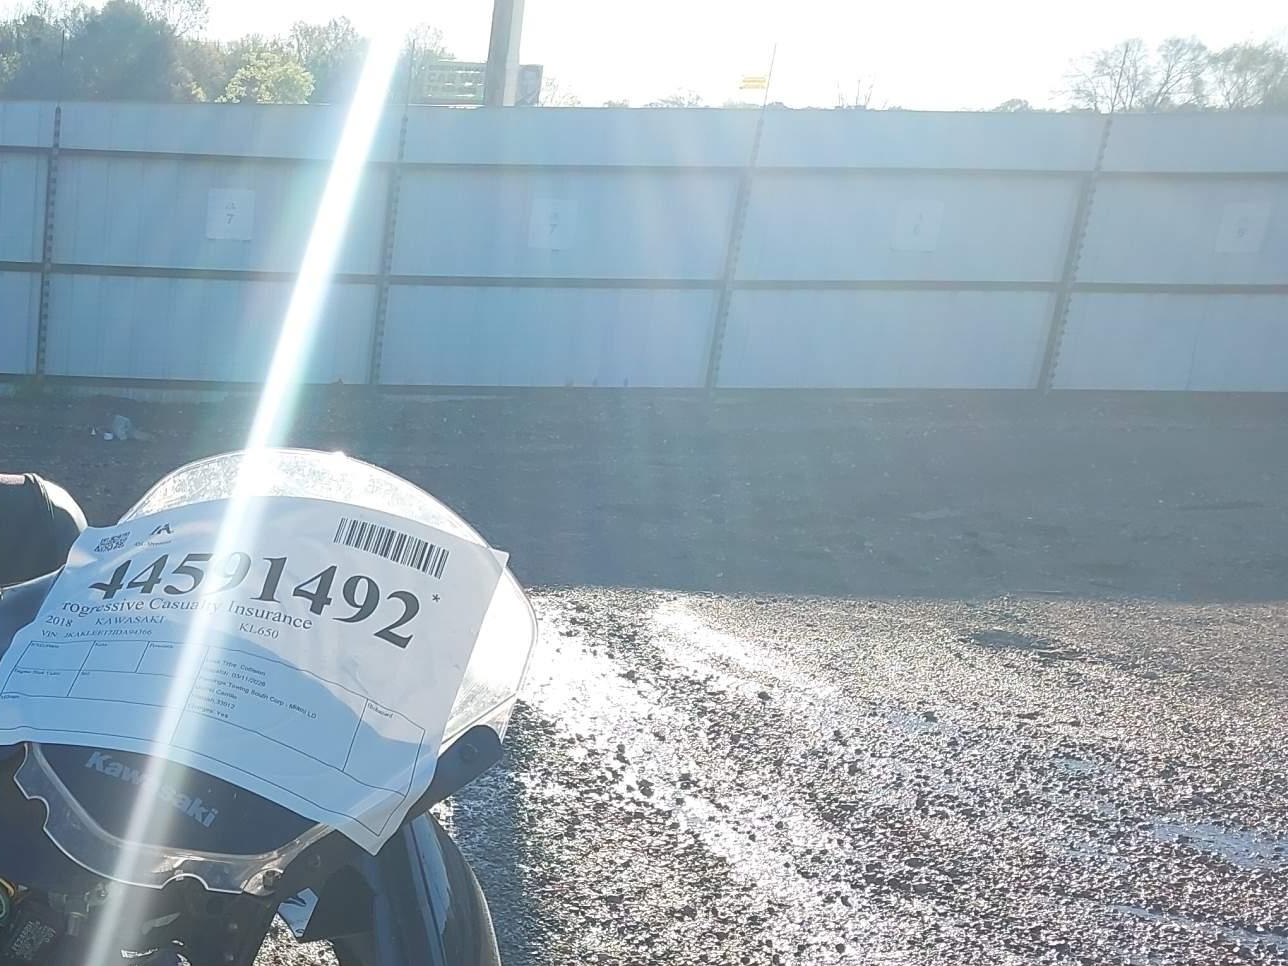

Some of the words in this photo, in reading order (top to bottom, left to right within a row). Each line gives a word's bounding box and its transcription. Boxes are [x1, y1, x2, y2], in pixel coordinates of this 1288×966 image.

[226, 213, 236, 225] 7
[46, 615, 73, 628] 2018
[94, 615, 167, 626] KAWASAKI
[239, 622, 280, 640] KL650
[62, 599, 145, 618] rogressive
[228, 600, 313, 629] Insurance
[84, 751, 219, 829] Kawsaki
